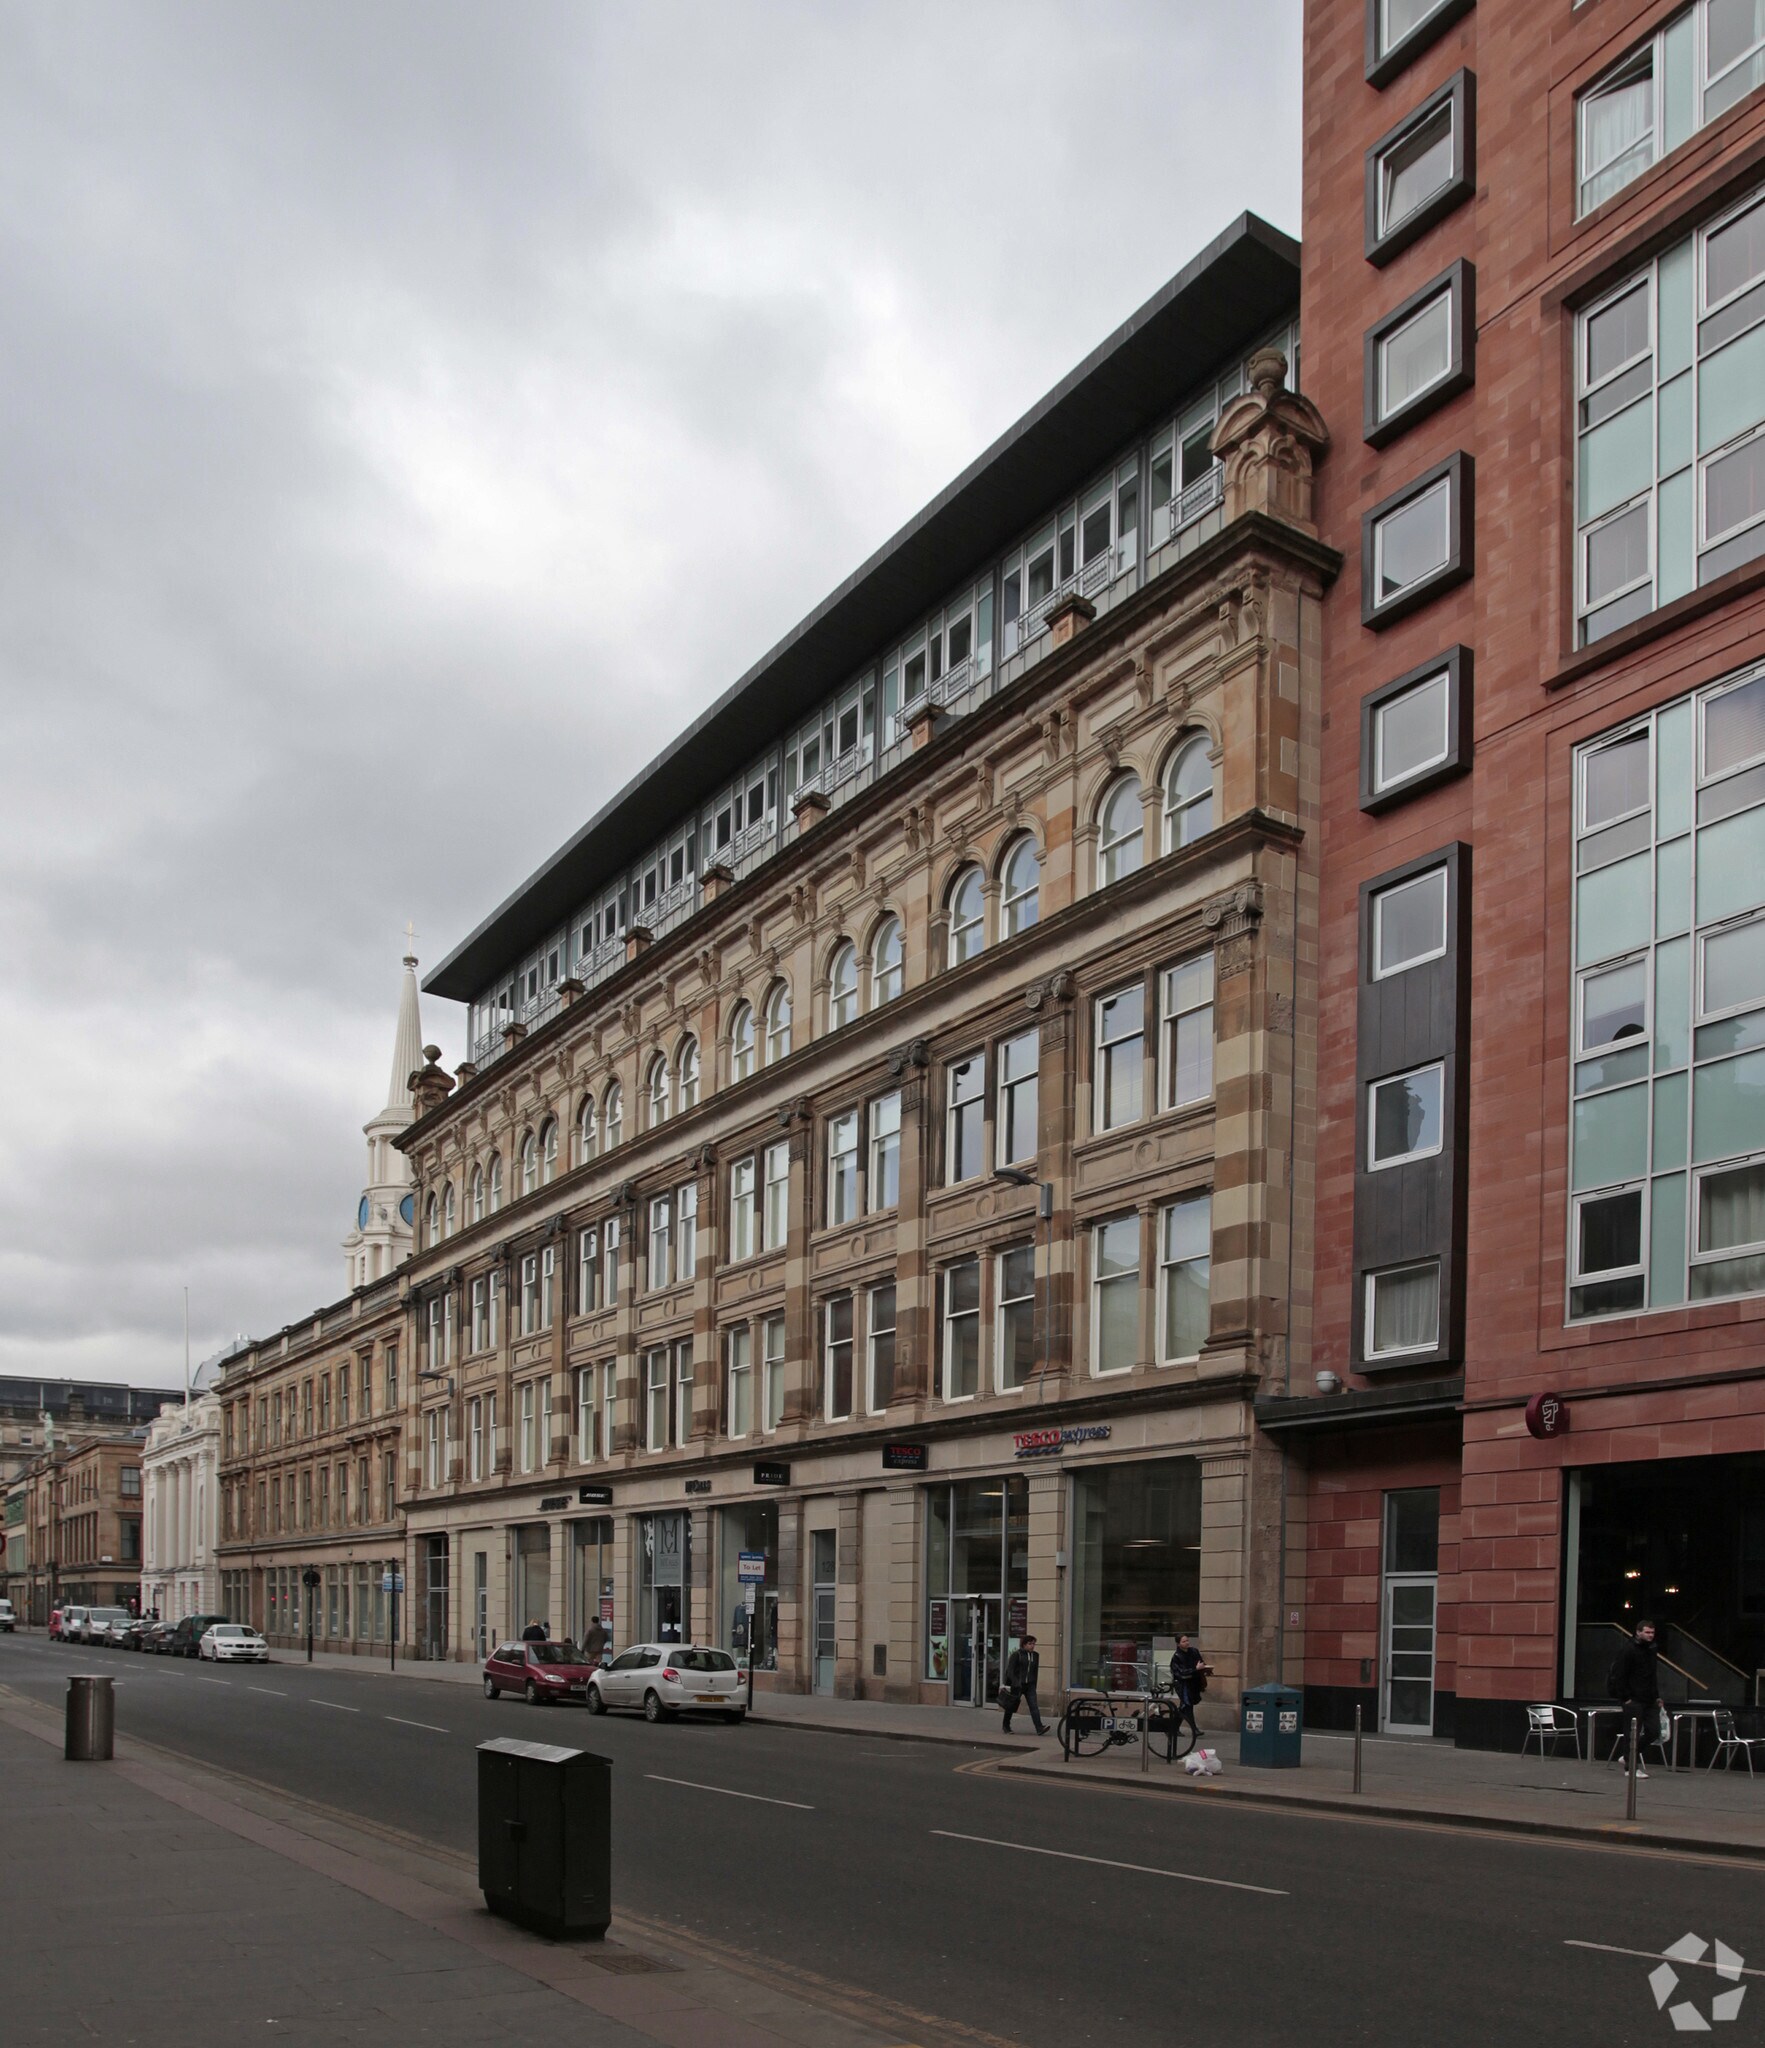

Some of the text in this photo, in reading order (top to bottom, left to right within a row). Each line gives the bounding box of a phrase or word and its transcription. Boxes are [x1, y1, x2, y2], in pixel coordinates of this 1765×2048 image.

[1013, 1426, 1111, 1448] TESCO express
[890, 1446, 921, 1456] TESCO
[1104, 1719, 1114, 1729] P
